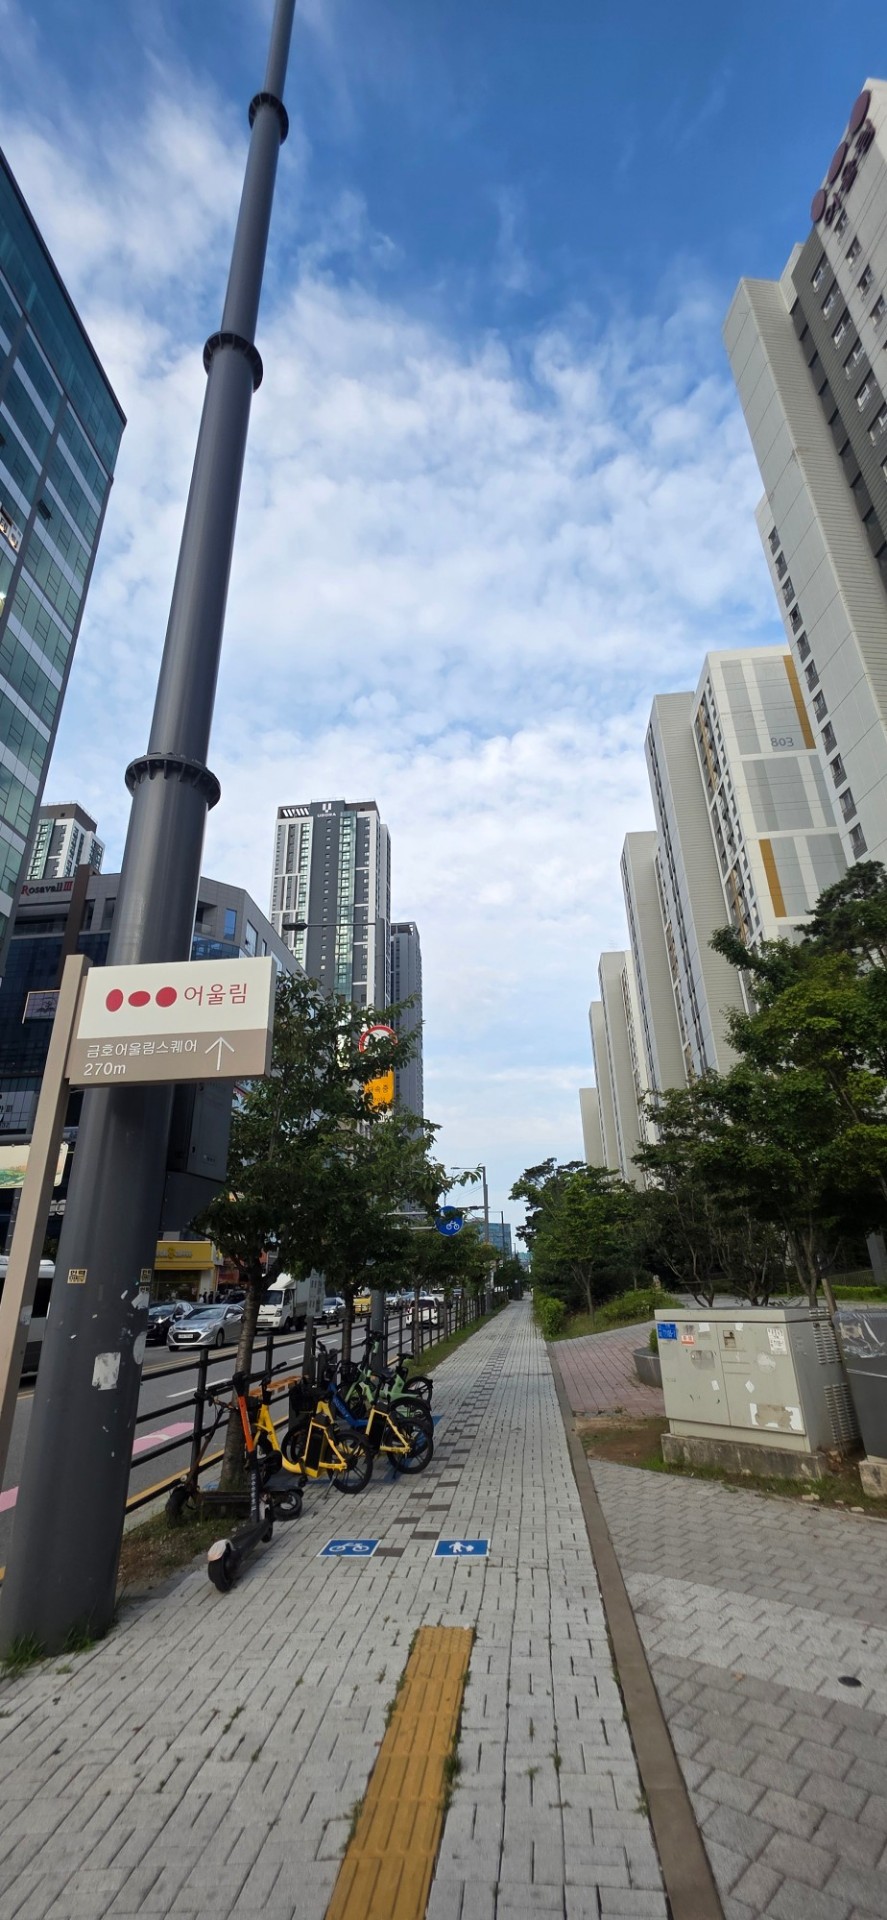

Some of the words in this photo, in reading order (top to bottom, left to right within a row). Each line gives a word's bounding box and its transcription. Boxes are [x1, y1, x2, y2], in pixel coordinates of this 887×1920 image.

[771, 737, 794, 747] 803
[184, 983, 247, 1006] 어울림
[86, 1039, 198, 1059] 금호어울림스퀘어
[83, 1062, 126, 1076] 270m
